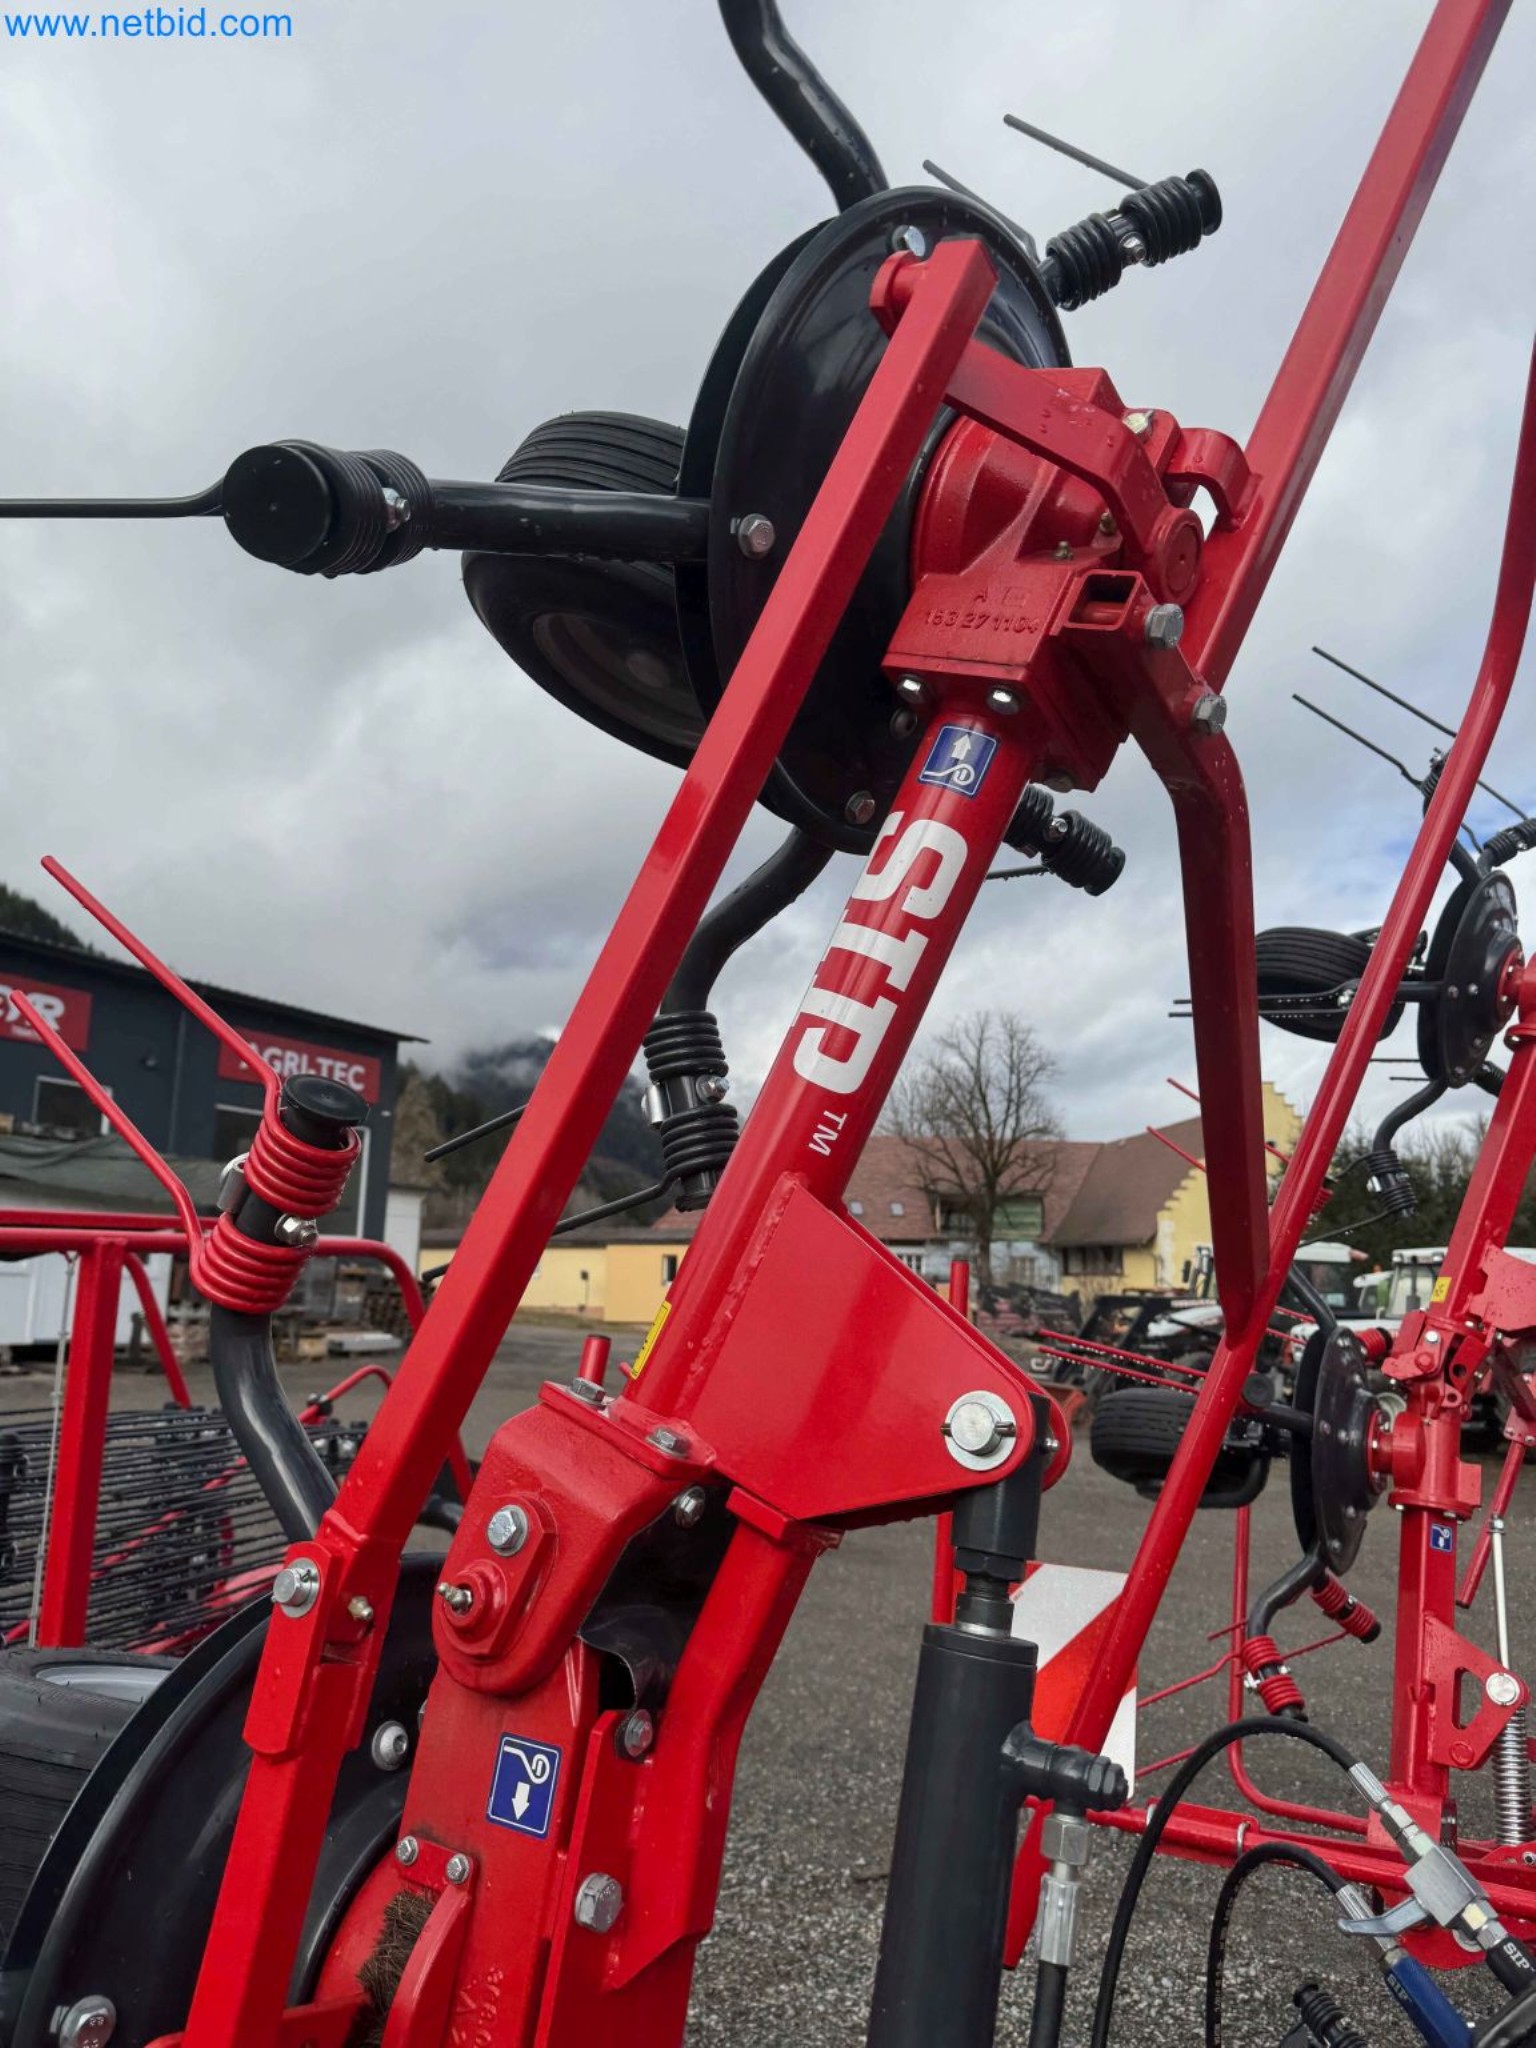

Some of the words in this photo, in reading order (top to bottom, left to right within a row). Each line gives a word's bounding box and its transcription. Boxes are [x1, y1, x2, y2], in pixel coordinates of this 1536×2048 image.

[793, 811, 968, 1094] SIP
[808, 1110, 848, 1157] TM
[1503, 1941, 1530, 1969] SIP
